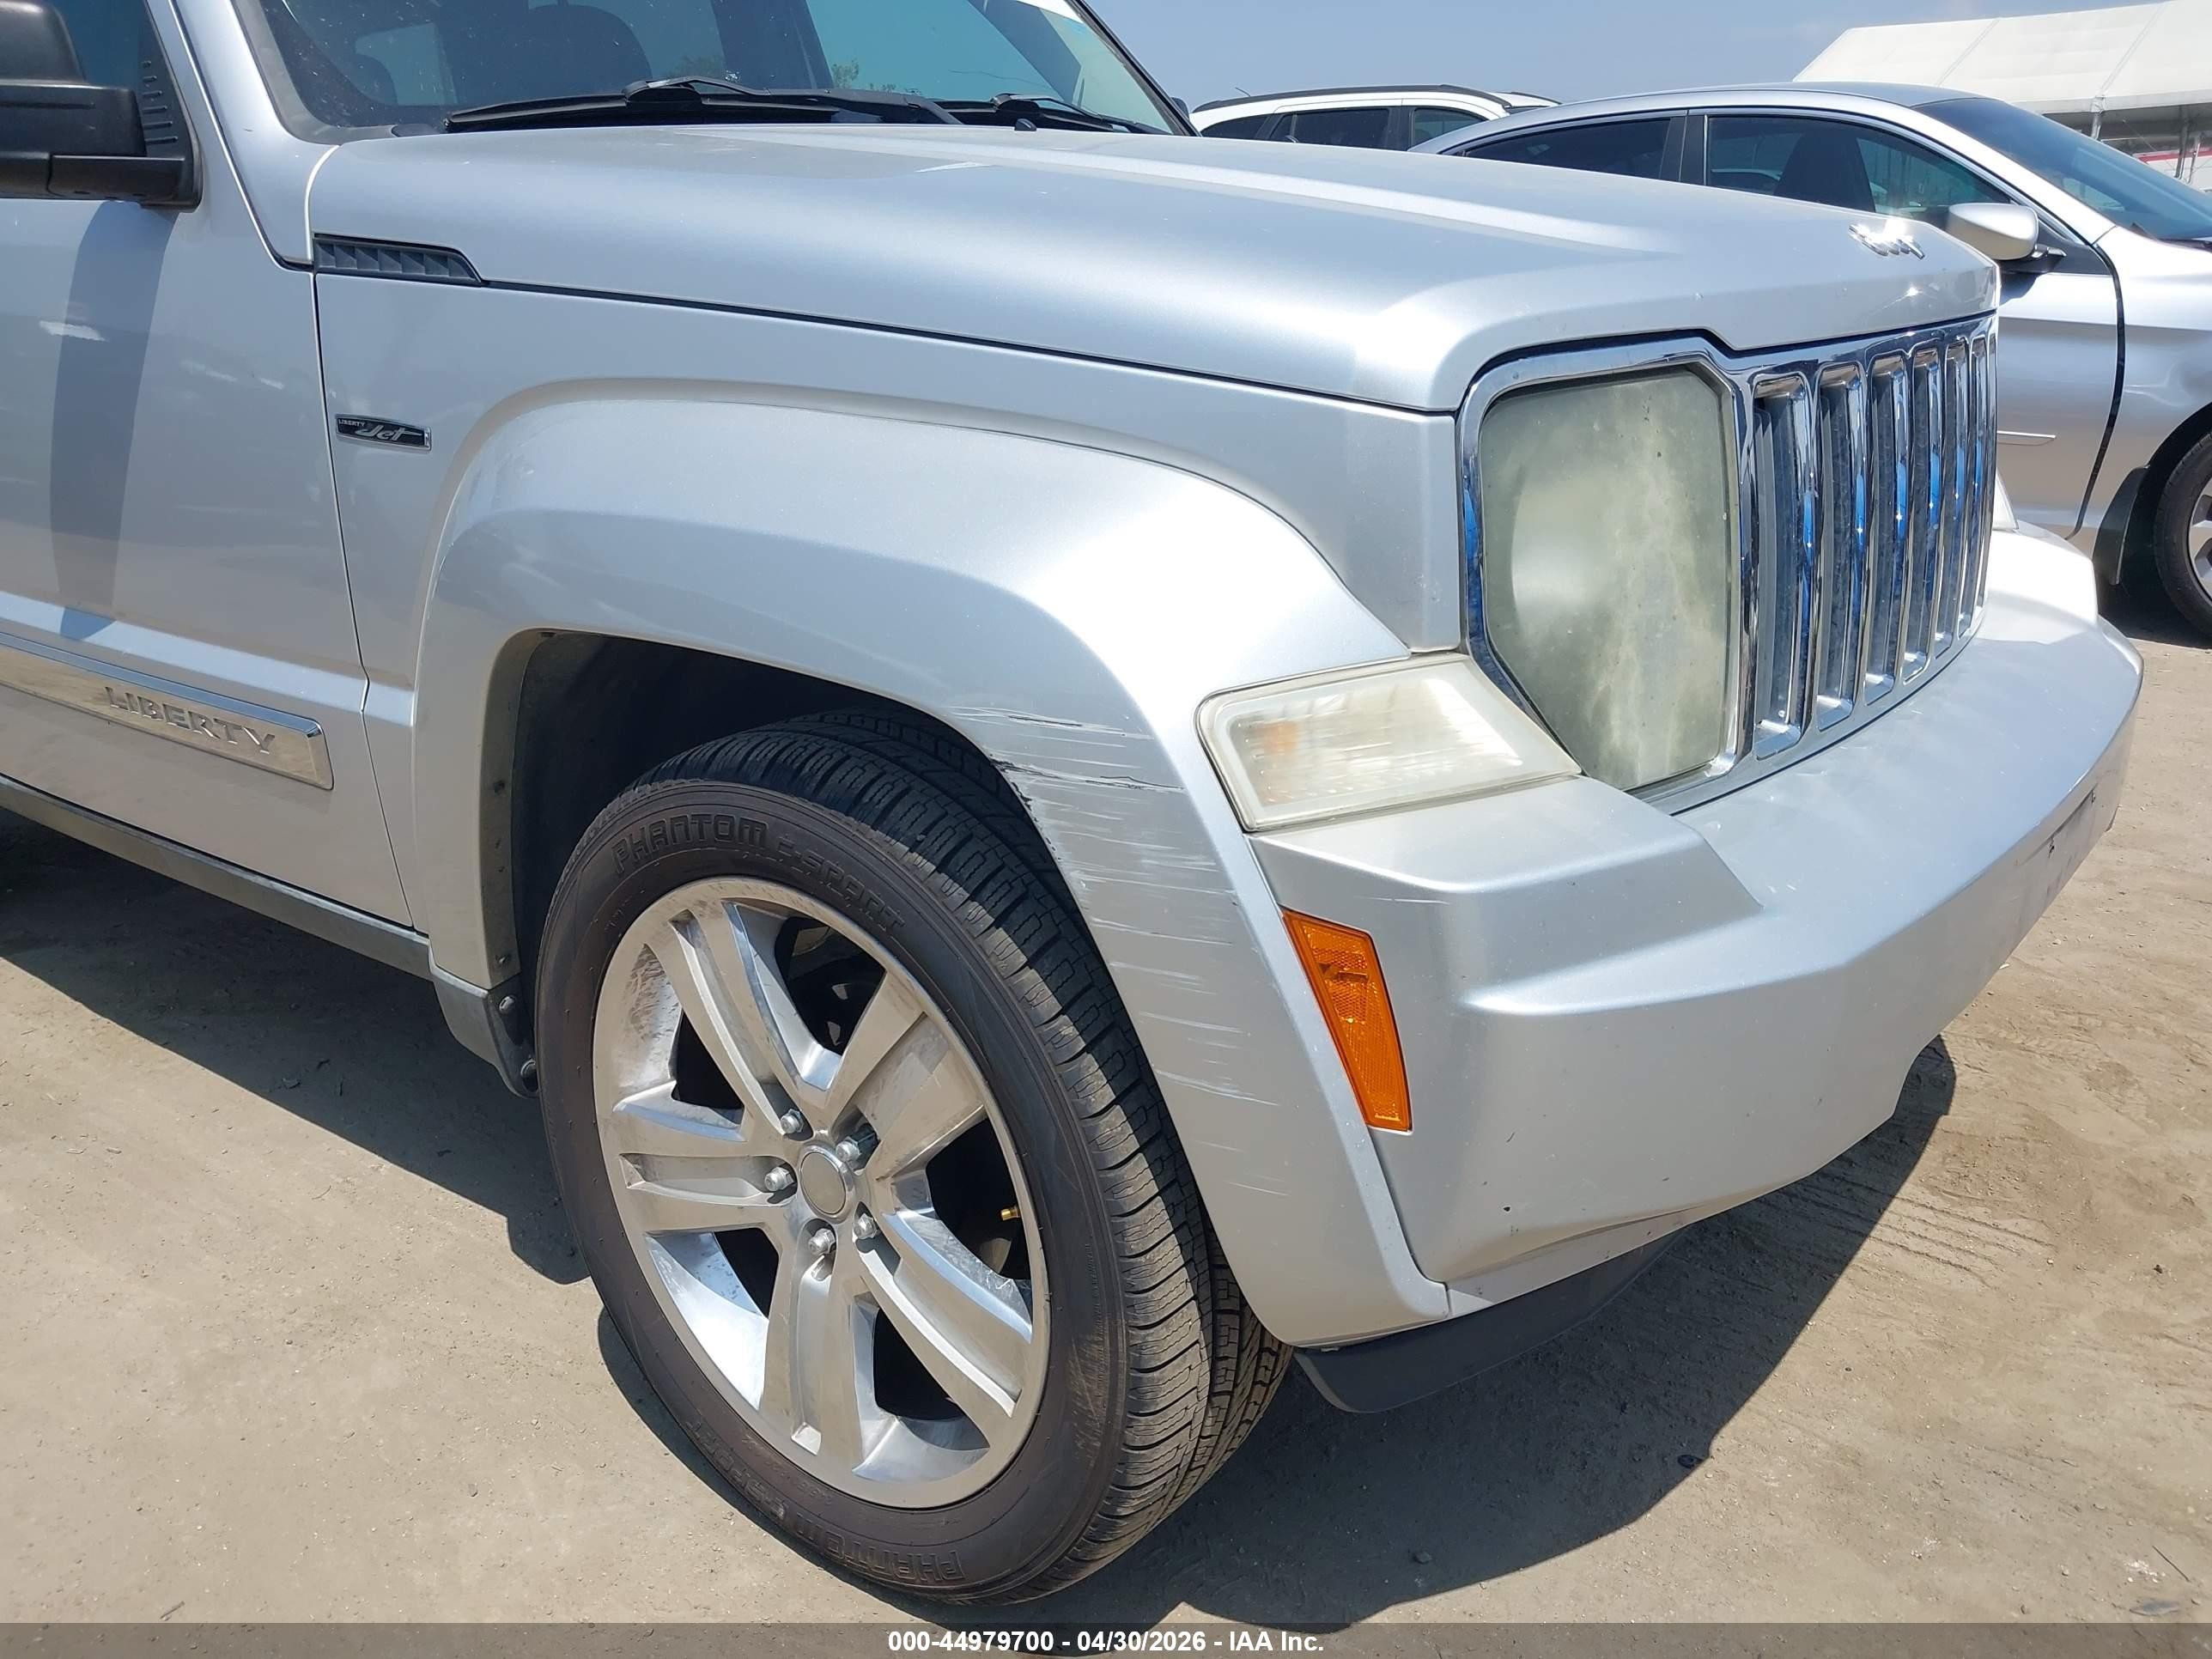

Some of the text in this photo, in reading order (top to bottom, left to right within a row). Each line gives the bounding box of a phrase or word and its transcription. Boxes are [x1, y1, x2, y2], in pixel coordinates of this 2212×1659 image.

[338, 418, 366, 427] LIBERTY
[356, 425, 423, 441] Jet
[105, 686, 276, 755] LIBERTY
[611, 814, 769, 874] PHANTOM
